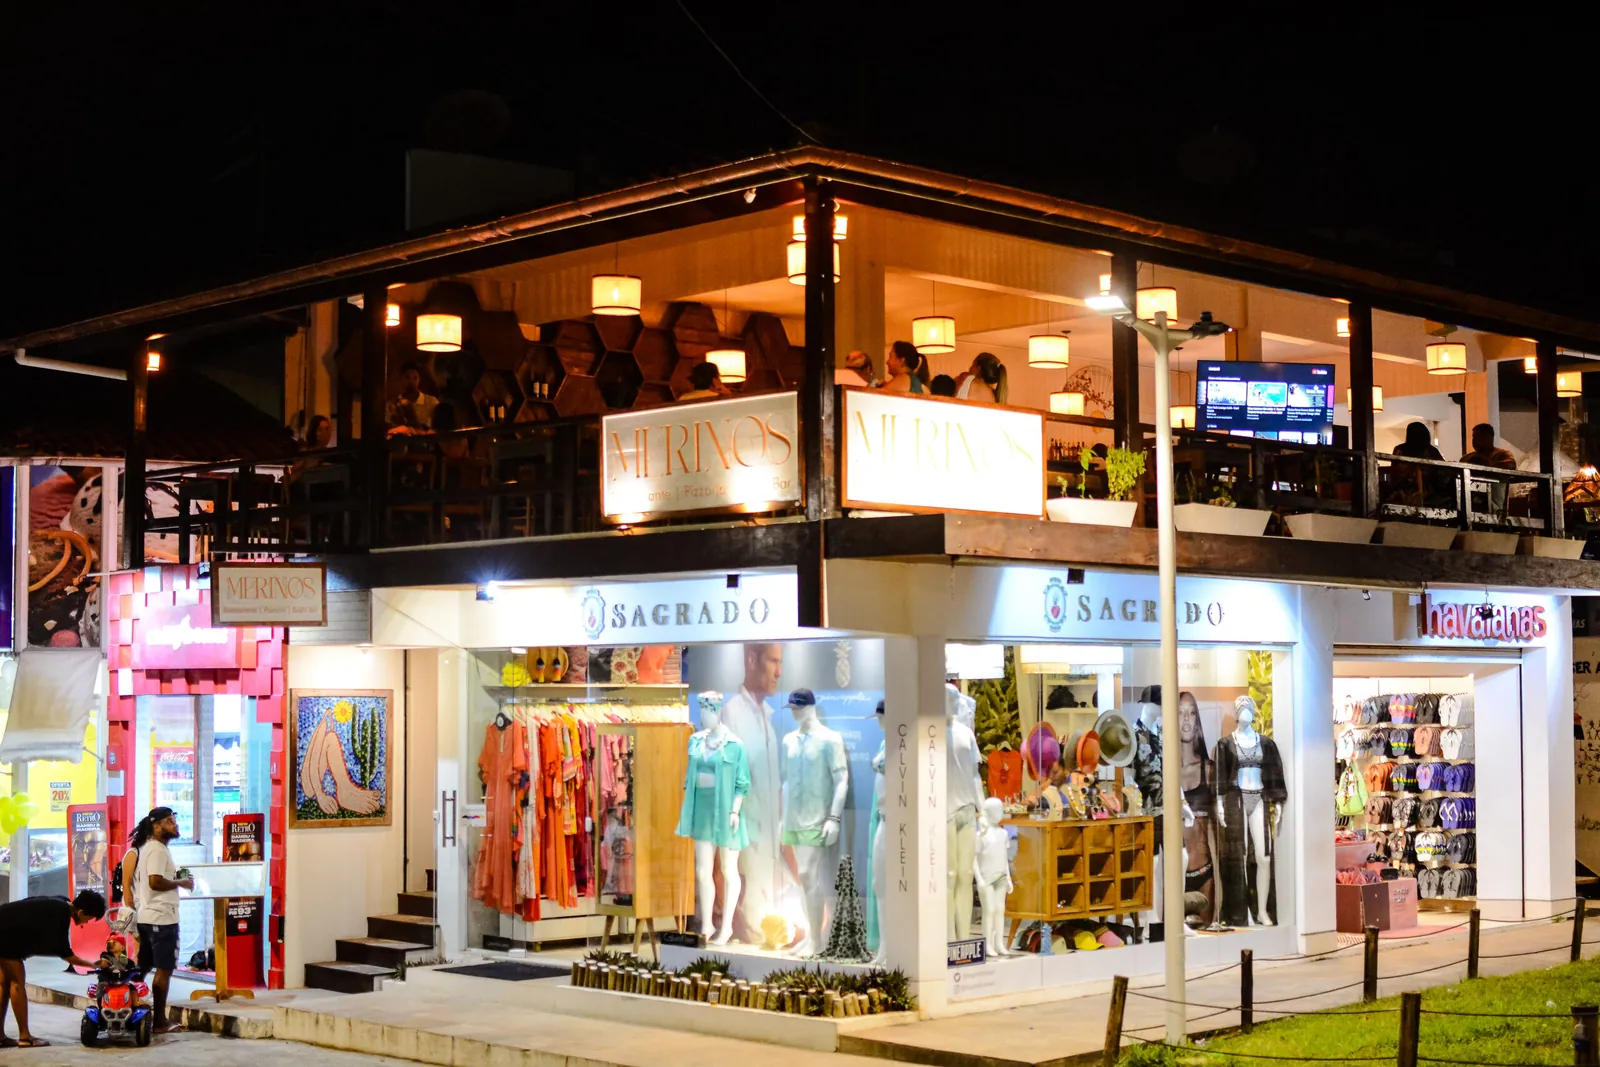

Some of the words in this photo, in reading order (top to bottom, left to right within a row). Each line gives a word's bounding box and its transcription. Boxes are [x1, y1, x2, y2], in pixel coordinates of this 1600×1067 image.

[612, 413, 791, 481] MERINOS
[227, 577, 315, 599] MERINOS
[1077, 595, 1224, 626] SAGRDO
[611, 598, 769, 628] SAGRADO
[898, 724, 907, 808] CALVIN
[928, 725, 937, 808] CALVIN
[52, 790, 70, 801] 20%
[899, 823, 907, 892] KLEIN
